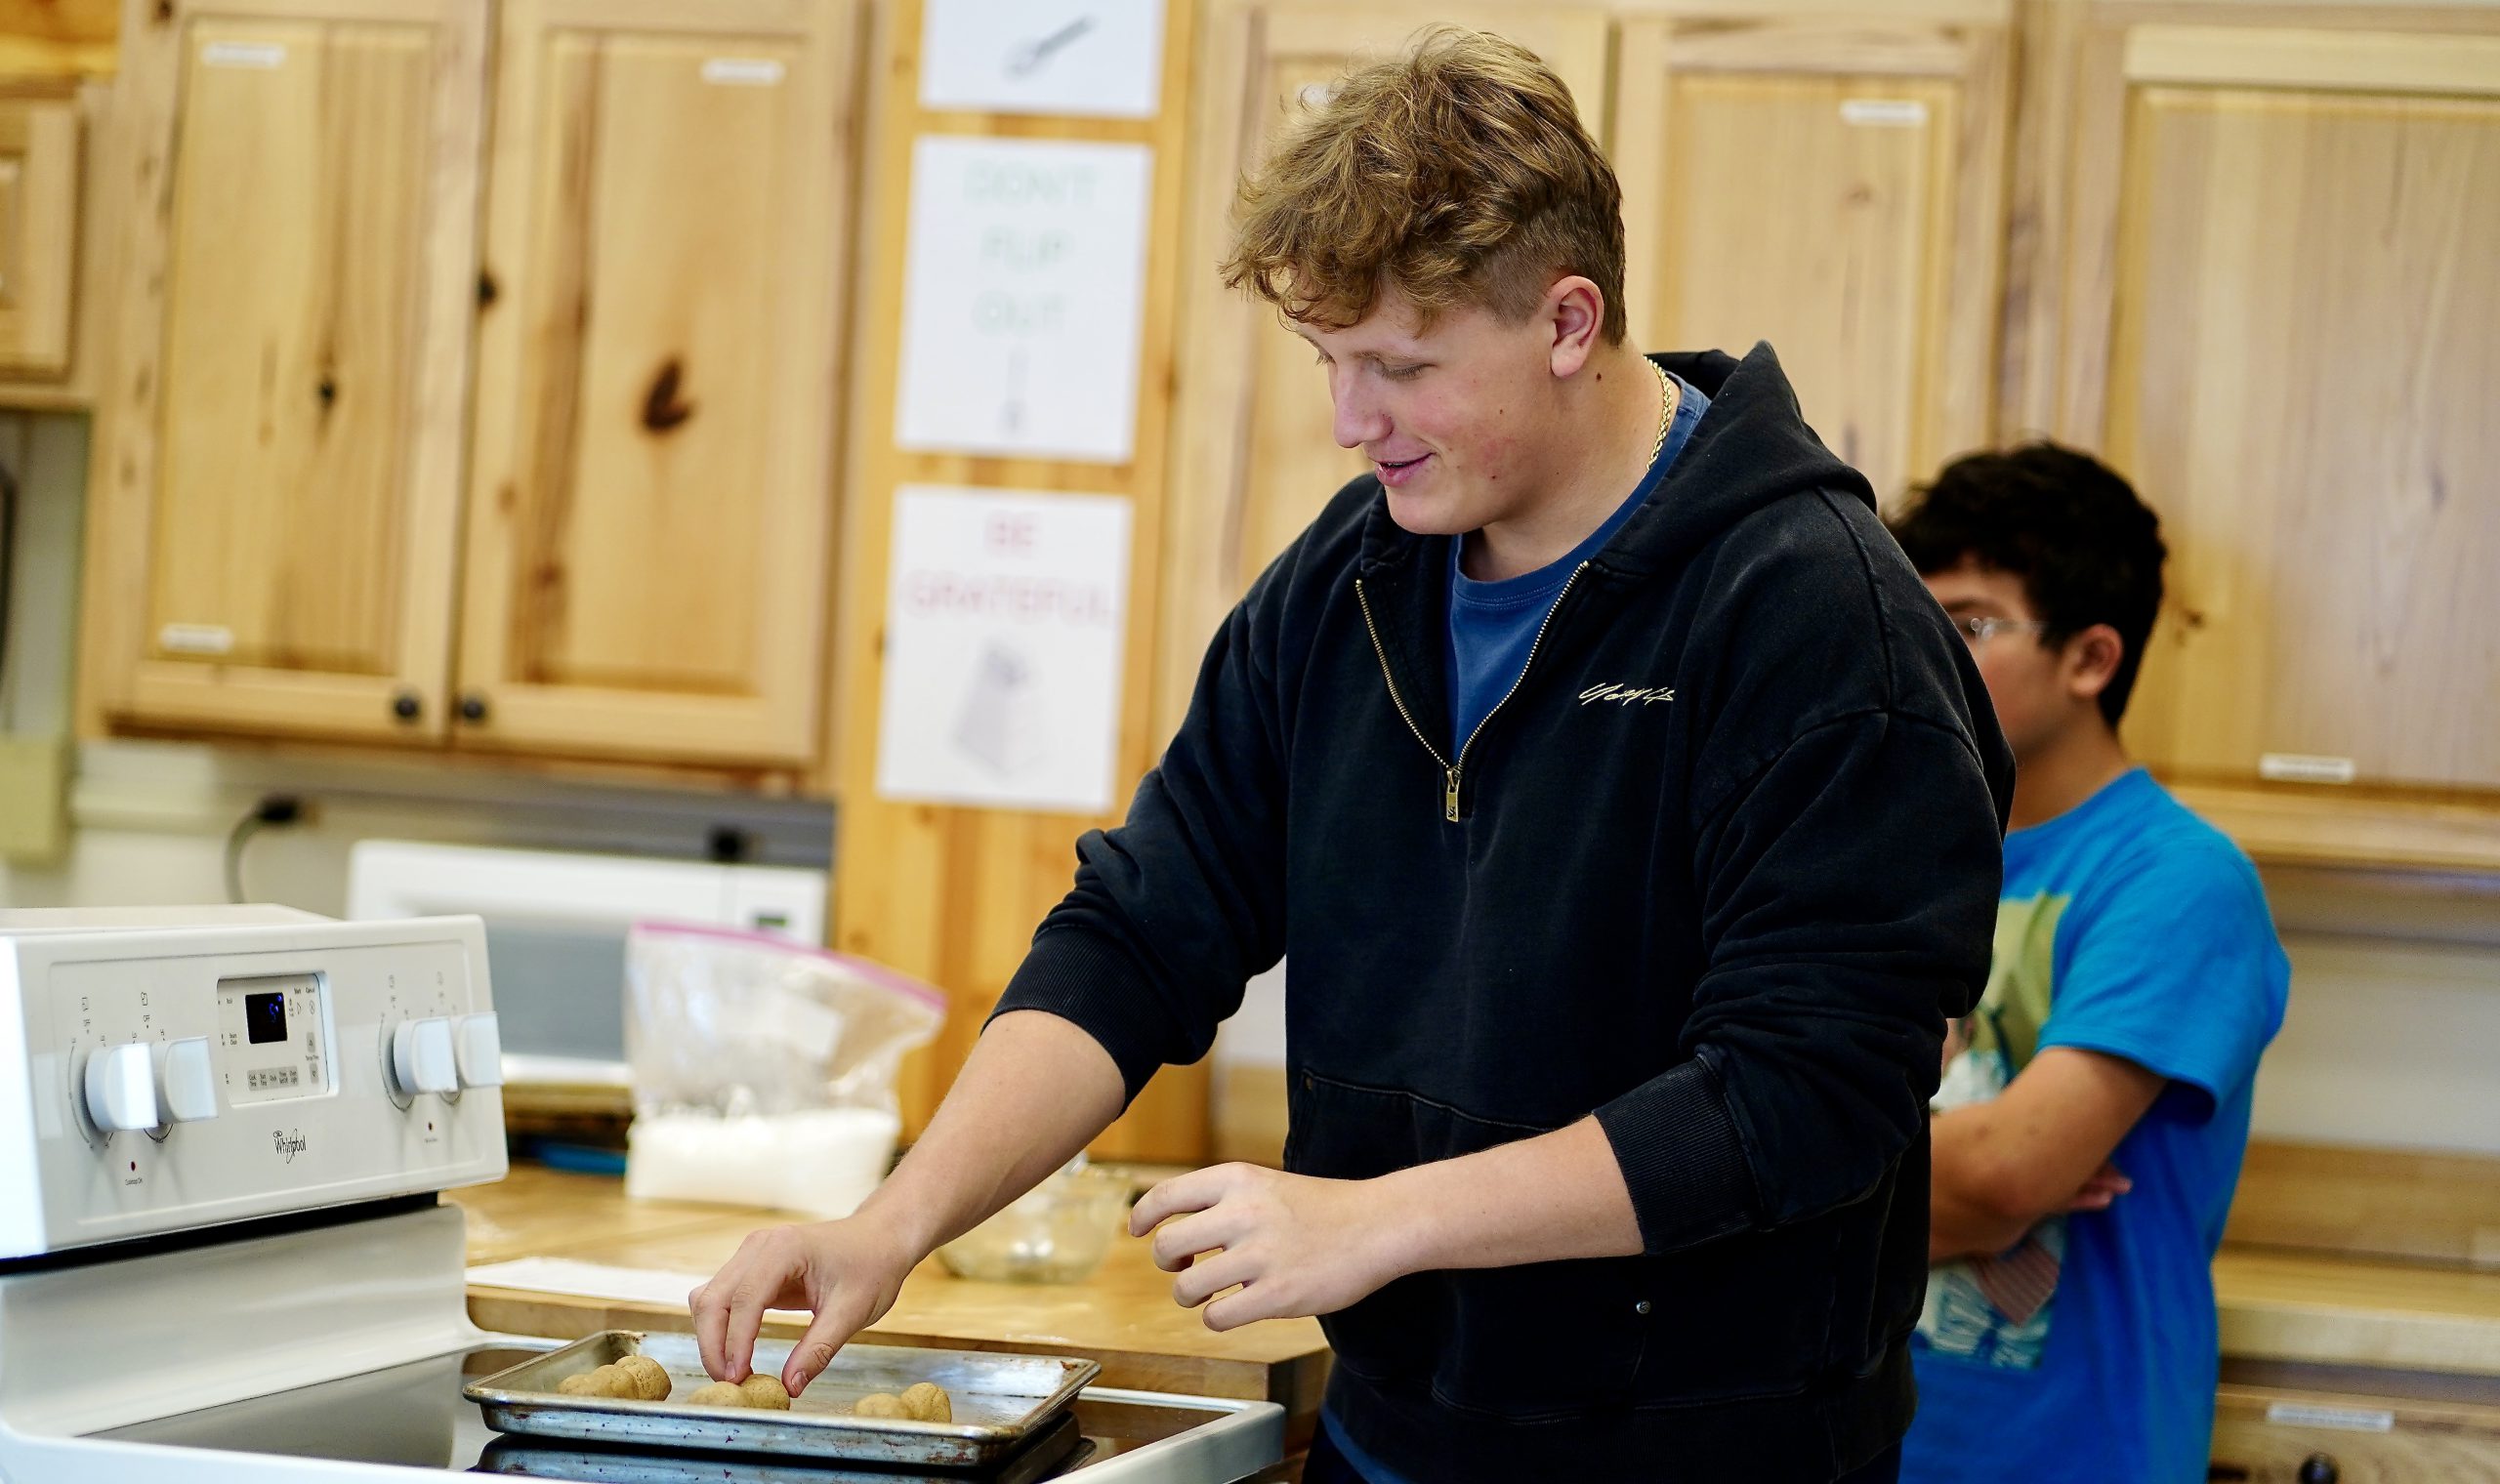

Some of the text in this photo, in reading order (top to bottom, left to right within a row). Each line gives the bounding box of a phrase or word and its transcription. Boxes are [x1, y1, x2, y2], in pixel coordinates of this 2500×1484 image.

[972, 291, 1069, 336] OUT
[984, 512, 1039, 558] BE
[902, 570, 1116, 628] GRATEFUL
[272, 1131, 307, 1161] Whirlpool
